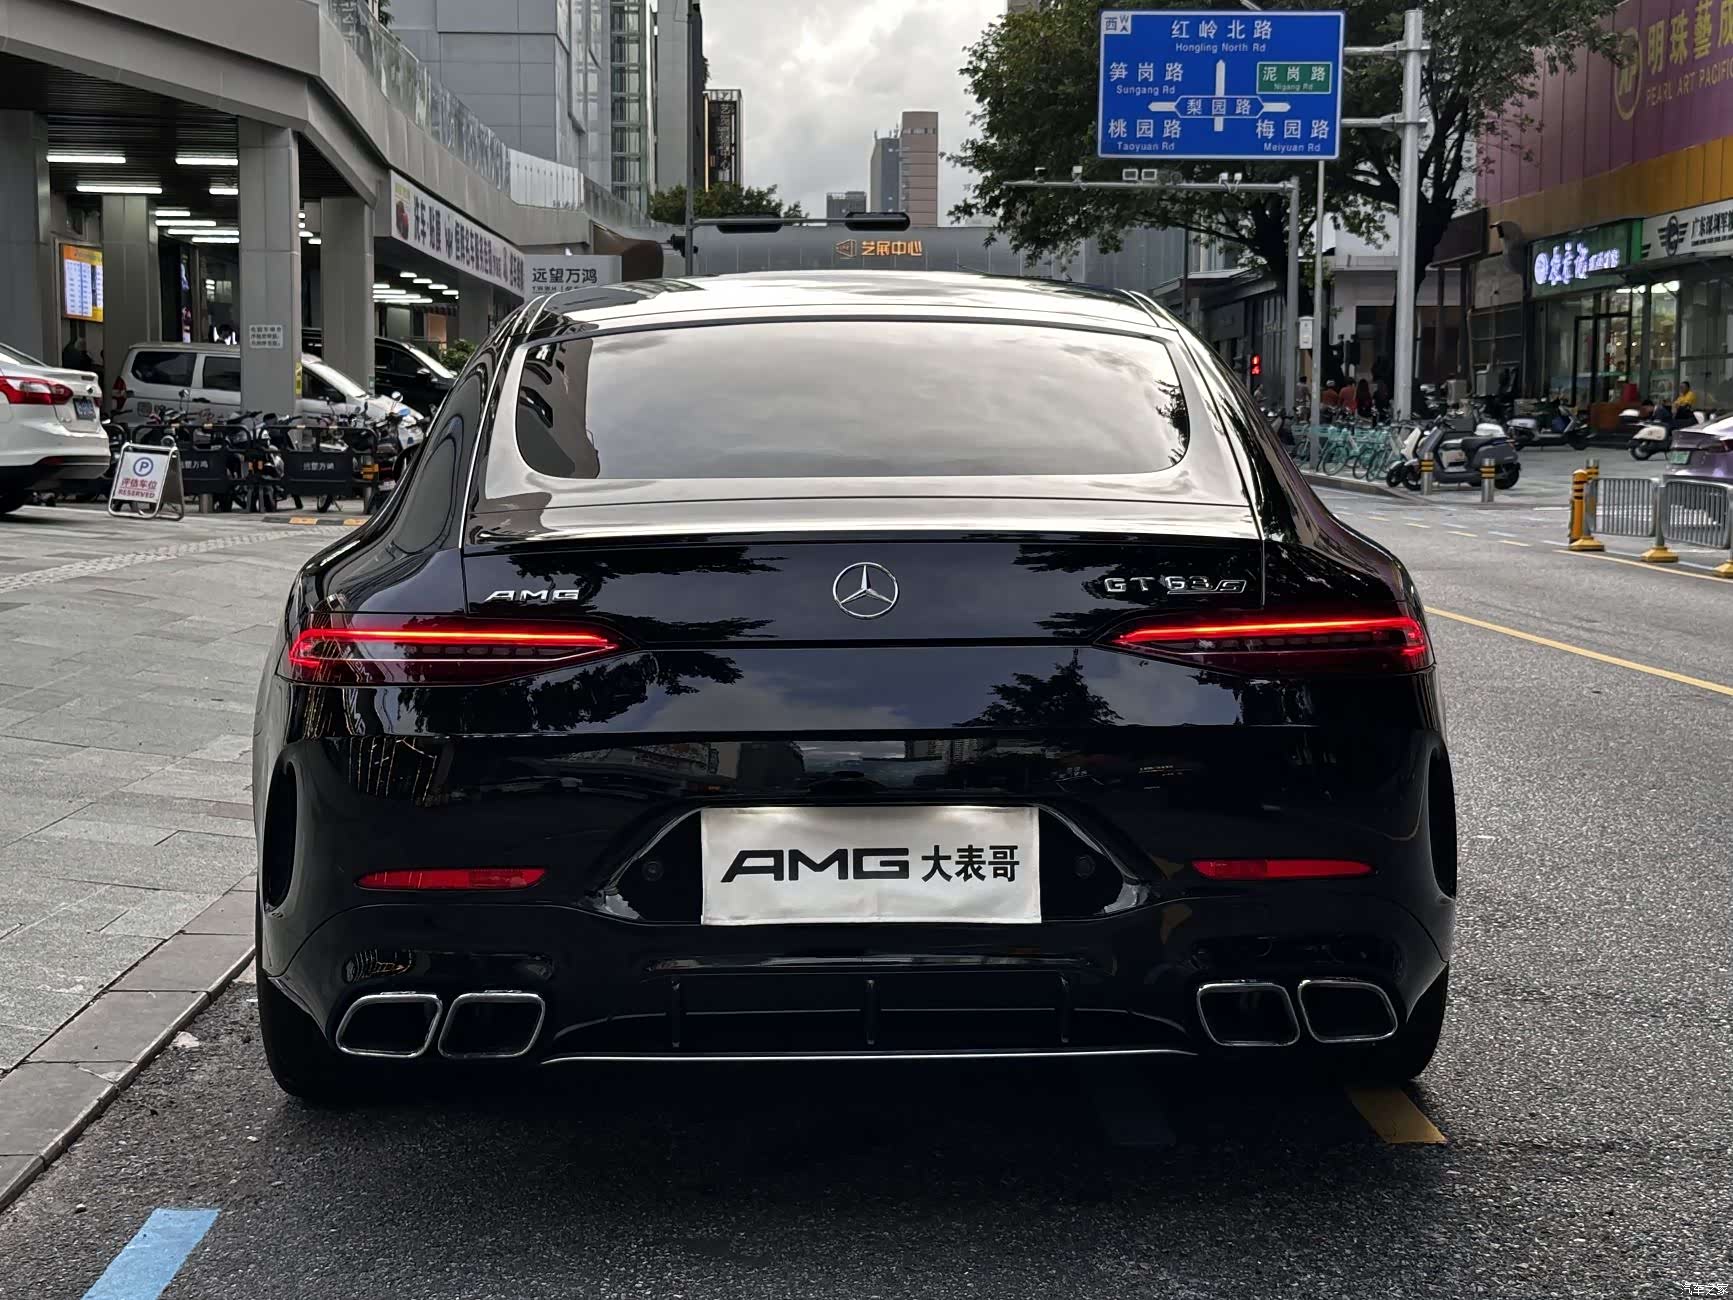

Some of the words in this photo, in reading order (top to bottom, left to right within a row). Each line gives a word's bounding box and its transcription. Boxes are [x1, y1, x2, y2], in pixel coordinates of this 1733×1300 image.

[1104, 17, 1118, 32] 西
[1119, 15, 1129, 24] W
[1171, 20, 1273, 40] 红岭北路
[1175, 42, 1218, 53] Hongling
[1221, 42, 1248, 52] North
[1252, 42, 1266, 52] Rd
[1109, 62, 1184, 82] 笋岗路
[1263, 66, 1326, 82] 泥岗路
[1116, 85, 1159, 96] Sungang
[1162, 85, 1176, 95] Rd
[1274, 83, 1300, 92] Nigang
[1302, 83, 1313, 91] Rd
[1186, 99, 1251, 115] 梨园路
[1108, 119, 1182, 139] 桃园路
[1256, 119, 1330, 139] 梅园路
[1117, 142, 1158, 152] Taoyuan
[1161, 142, 1175, 151] Rd
[1263, 142, 1305, 153] Meiyuan
[1307, 142, 1321, 152] Rd
[861, 240, 922, 256] 艺展中心
[532, 267, 598, 284] 远望万鸿
[121, 477, 158, 490] 评估车位
[118, 489, 156, 499] RESERVED
[1103, 576, 1156, 593] GT
[485, 589, 580, 602] AMG
[720, 847, 910, 883] AMG
[921, 844, 1020, 882] 大表哥
